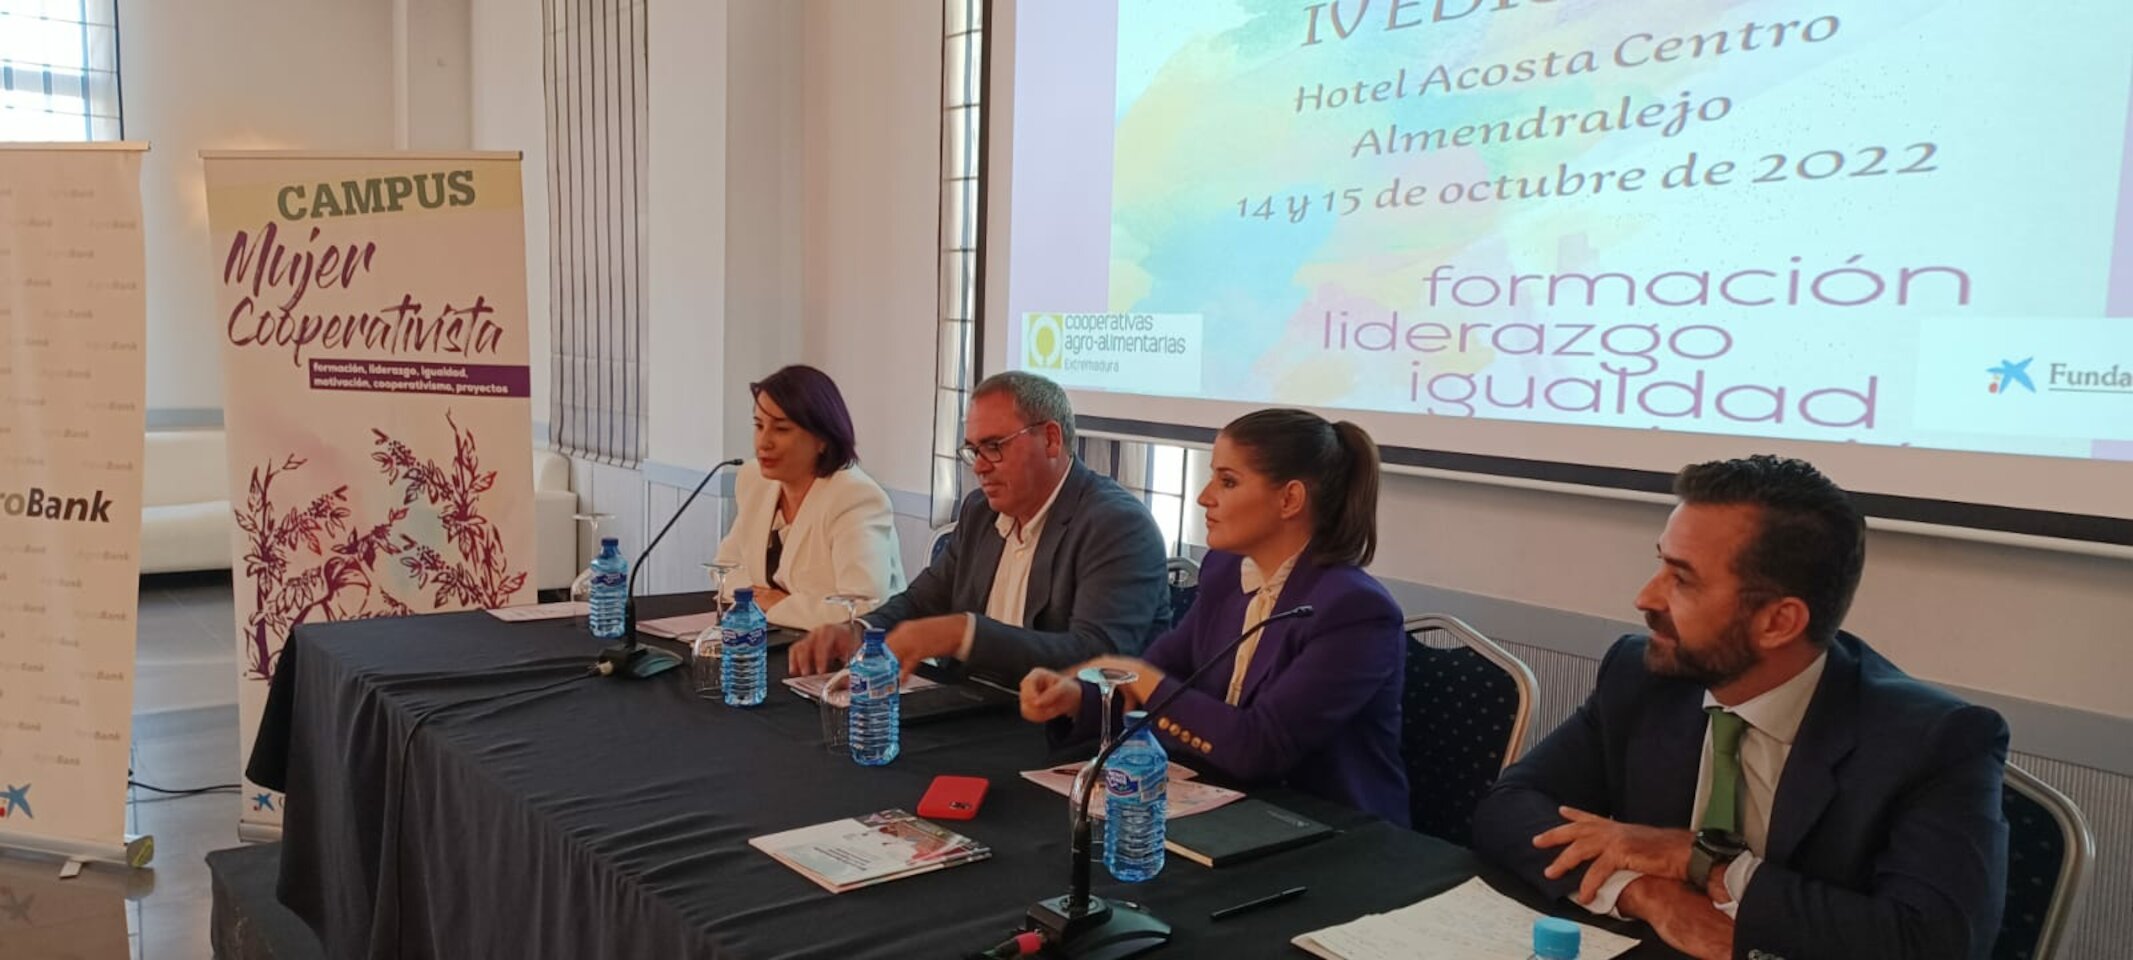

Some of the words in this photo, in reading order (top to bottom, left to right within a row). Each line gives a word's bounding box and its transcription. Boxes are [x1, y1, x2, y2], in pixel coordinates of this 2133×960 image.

[1301, 0, 1369, 47] IV
[1294, 68, 1406, 113] Hotel
[1418, 50, 1600, 95] Acosta
[1613, 14, 1841, 69] Centro
[1351, 90, 1733, 158] Almendralejo
[277, 169, 476, 221] CAMPUS
[1237, 197, 1276, 221] 14
[1287, 193, 1312, 223] y
[1323, 187, 1363, 216] 15
[1375, 178, 1428, 210] de
[1438, 164, 1648, 206] octubre
[1661, 151, 1736, 190] de
[1752, 142, 1939, 184] 2022
[223, 221, 377, 313] Mujer
[1422, 254, 1972, 309] formación
[227, 293, 503, 368] Cooperativista
[1064, 314, 1154, 332] cooperativas
[1064, 333, 1187, 354] agro-alimentarias
[1323, 311, 1733, 377] liderazgo
[1410, 361, 1878, 430] igualdad
